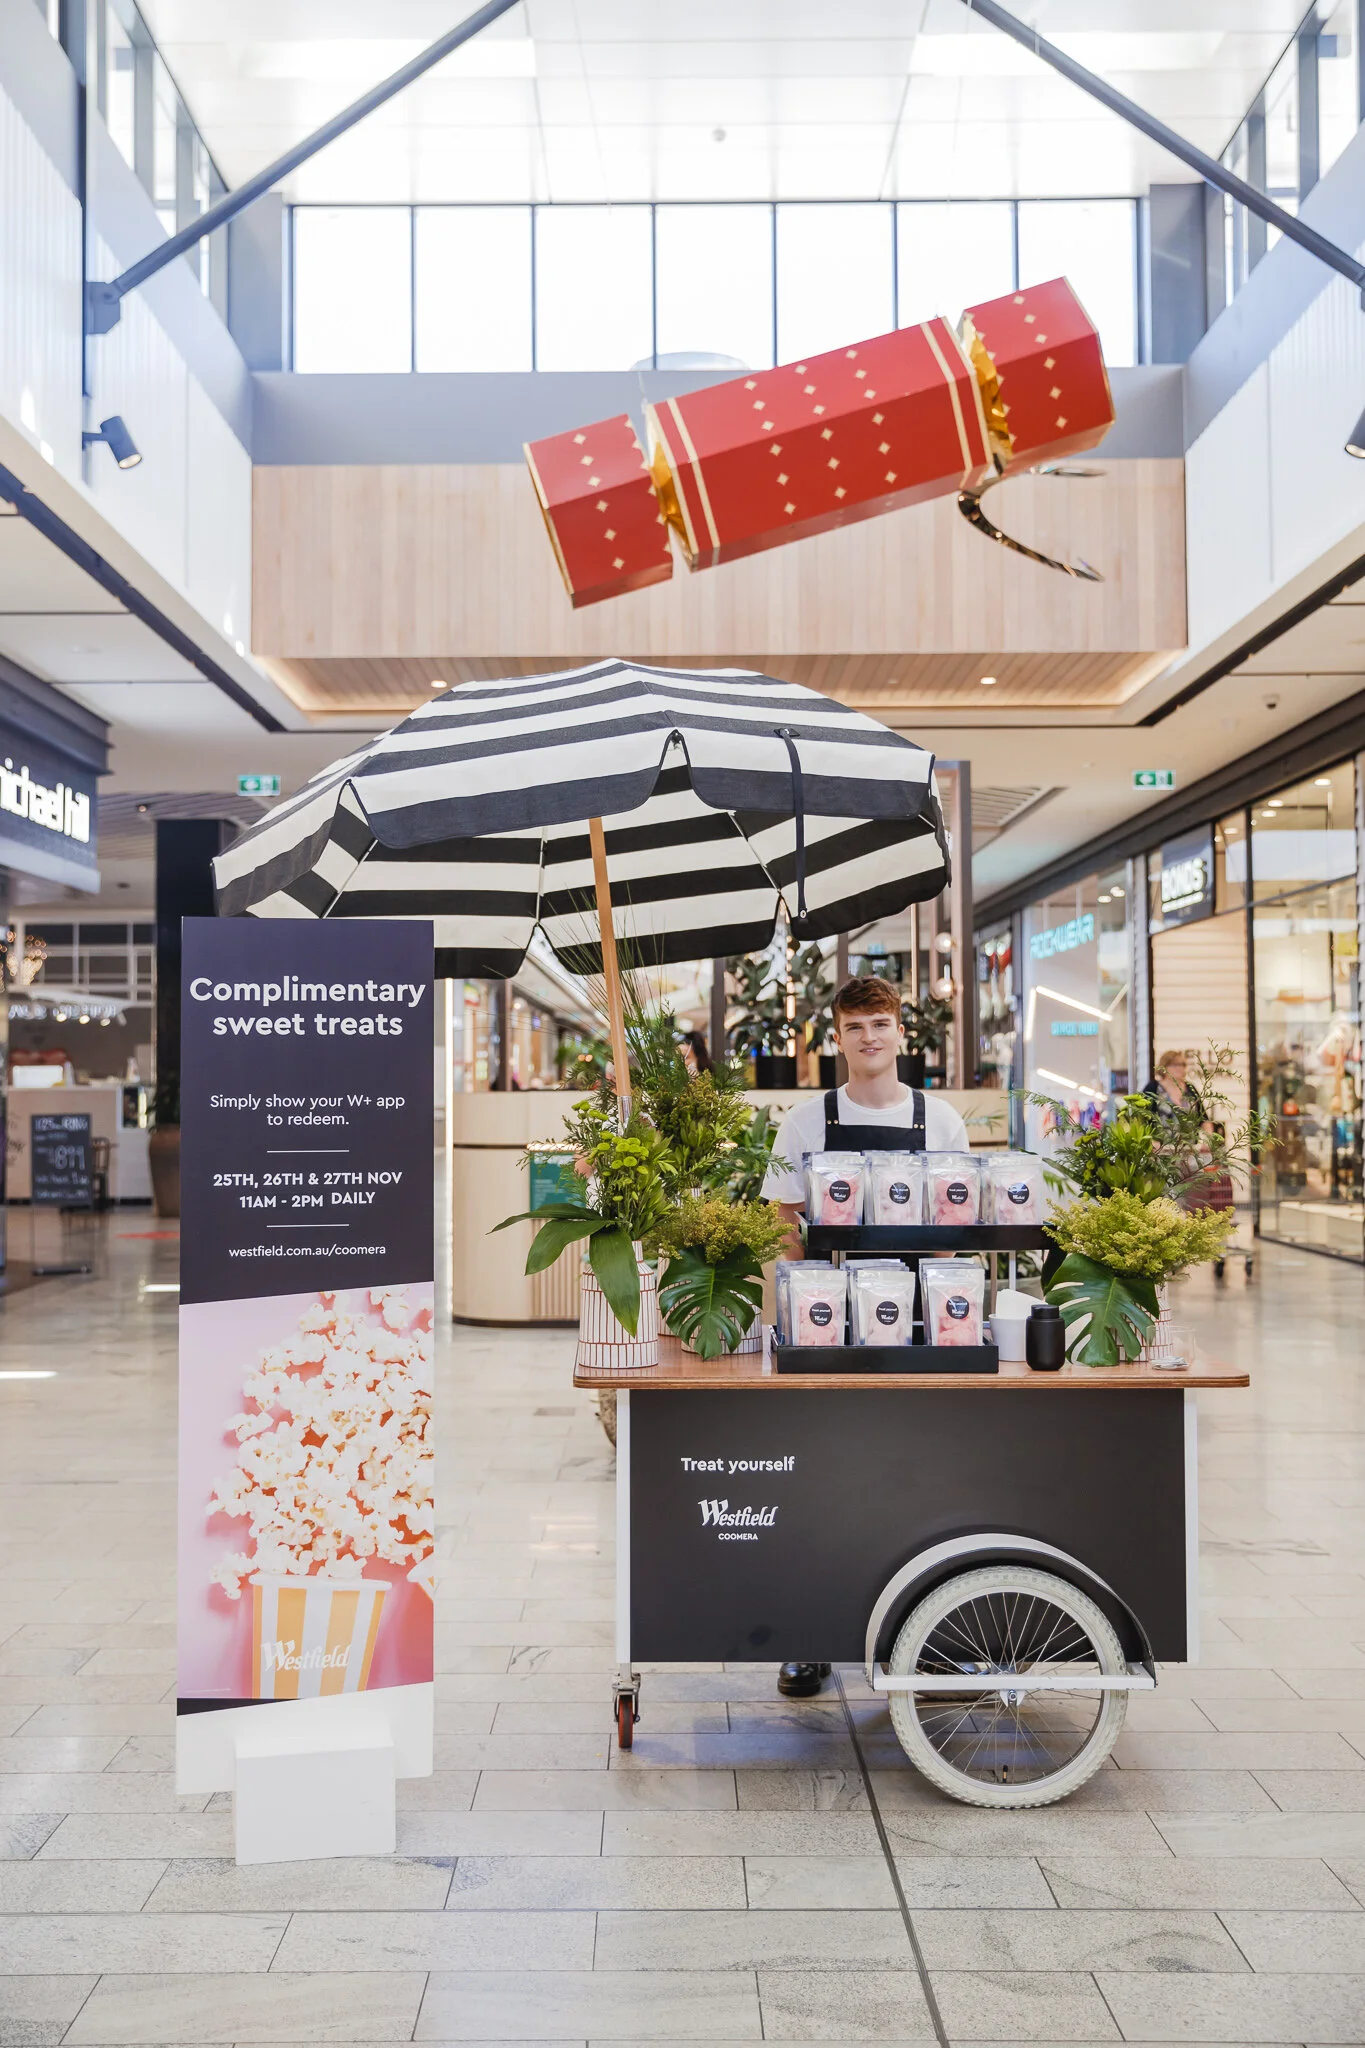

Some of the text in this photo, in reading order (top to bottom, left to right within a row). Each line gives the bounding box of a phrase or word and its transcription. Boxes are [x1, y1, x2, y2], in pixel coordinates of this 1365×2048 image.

[190, 975, 426, 1008] Complimentary
[213, 1013, 403, 1036] sweet treats
[210, 1093, 405, 1110] Simply show your W+ app
[267, 1112, 350, 1125] to redeem.
[213, 1171, 403, 1188] 25TH, 26TH & 27TH NOV
[239, 1195, 277, 1208] 11AM
[291, 1195, 324, 1207] 2PM
[331, 1192, 376, 1205] DAILY
[229, 1244, 386, 1257] westfield.com.au/coomera
[680, 1456, 795, 1475] Treat yourself
[697, 1499, 779, 1527] Westfield
[718, 1533, 759, 1541] COOMERA
[260, 1639, 351, 1672] Westfield
